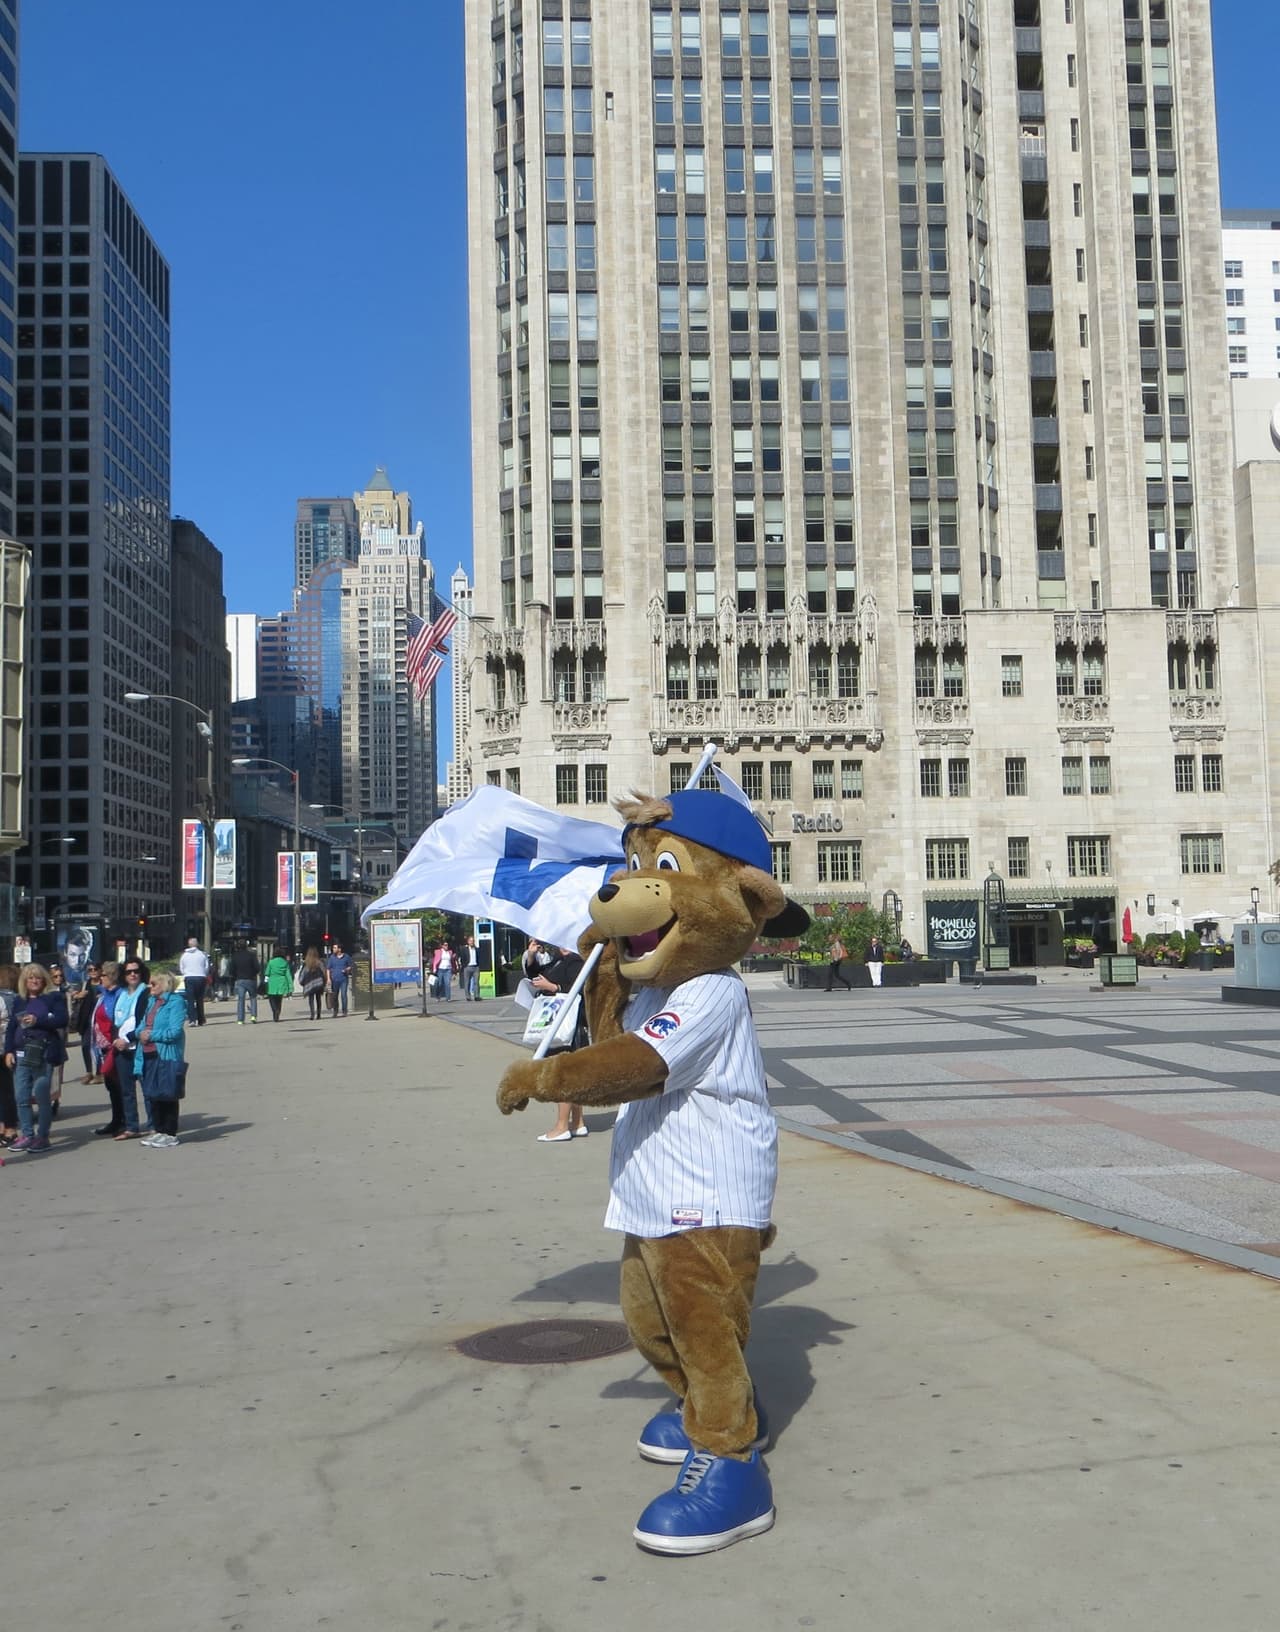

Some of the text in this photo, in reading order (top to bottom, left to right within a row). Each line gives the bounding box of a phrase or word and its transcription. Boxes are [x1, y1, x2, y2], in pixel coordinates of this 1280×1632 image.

[792, 813, 843, 833] Radio
[929, 916, 976, 929] HOWELLS
[941, 928, 976, 940] HOOD
